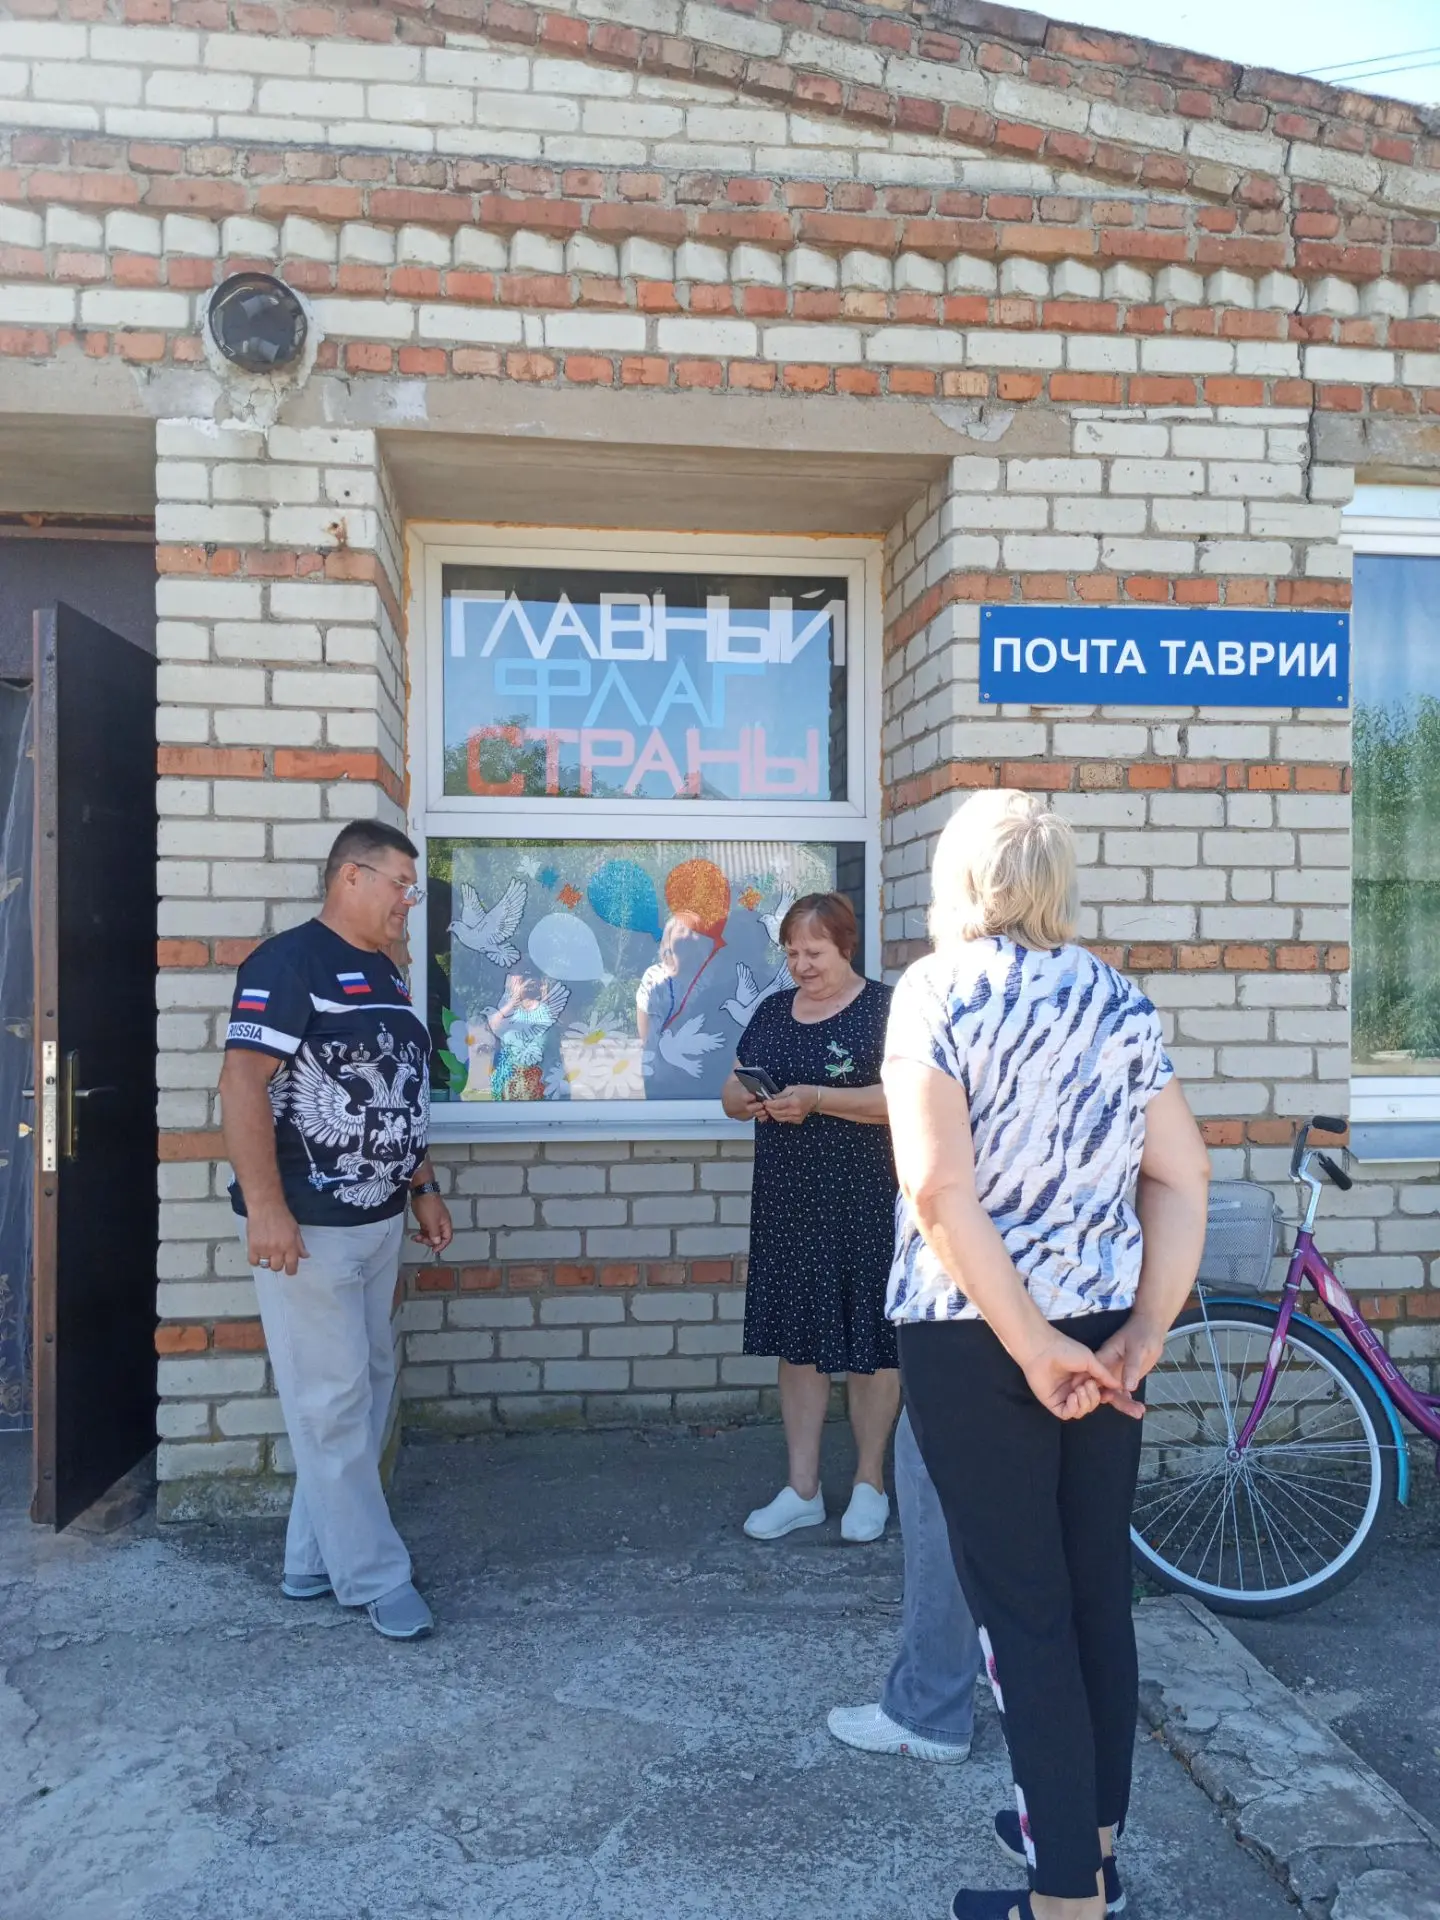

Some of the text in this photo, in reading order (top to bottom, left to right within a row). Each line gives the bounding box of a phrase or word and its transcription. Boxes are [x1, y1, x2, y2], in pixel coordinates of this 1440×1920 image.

[450, 589, 845, 666] ГЛАВНЫЙ
[993, 637, 1337, 677] ПОЧТА ТАВРИИ
[494, 658, 766, 727] ФЛАГ
[467, 724, 819, 796] СТРАНЫ
[228, 1023, 263, 1041] RUSSIA
